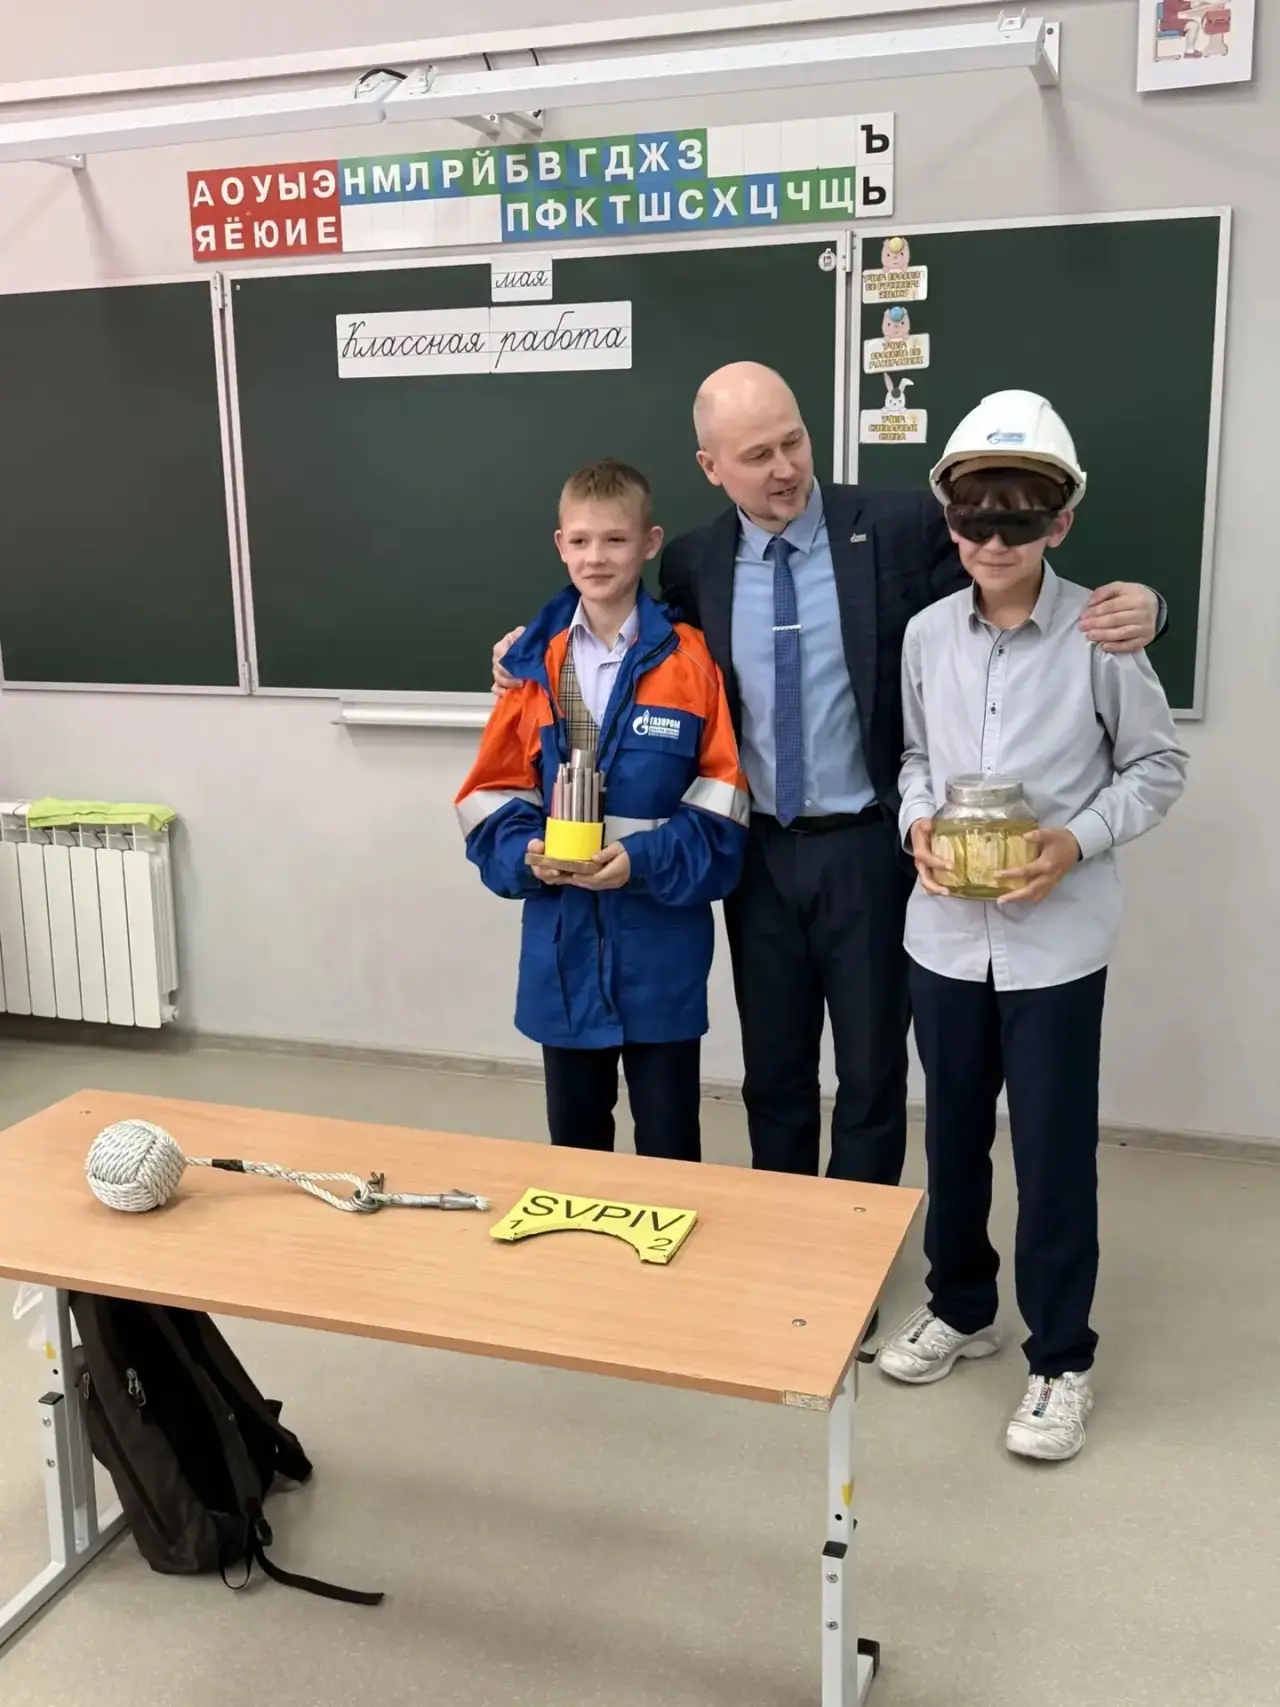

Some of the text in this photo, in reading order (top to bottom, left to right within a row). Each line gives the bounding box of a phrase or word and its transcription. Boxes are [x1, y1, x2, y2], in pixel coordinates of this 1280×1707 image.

[495, 270, 549, 289] мая
[342, 311, 628, 369] Классная работа
[649, 716, 681, 729] ГАЗПРОМ
[522, 1195, 686, 1232] SVPIV
[509, 1218, 524, 1230] 1
[646, 1237, 674, 1251] 2
